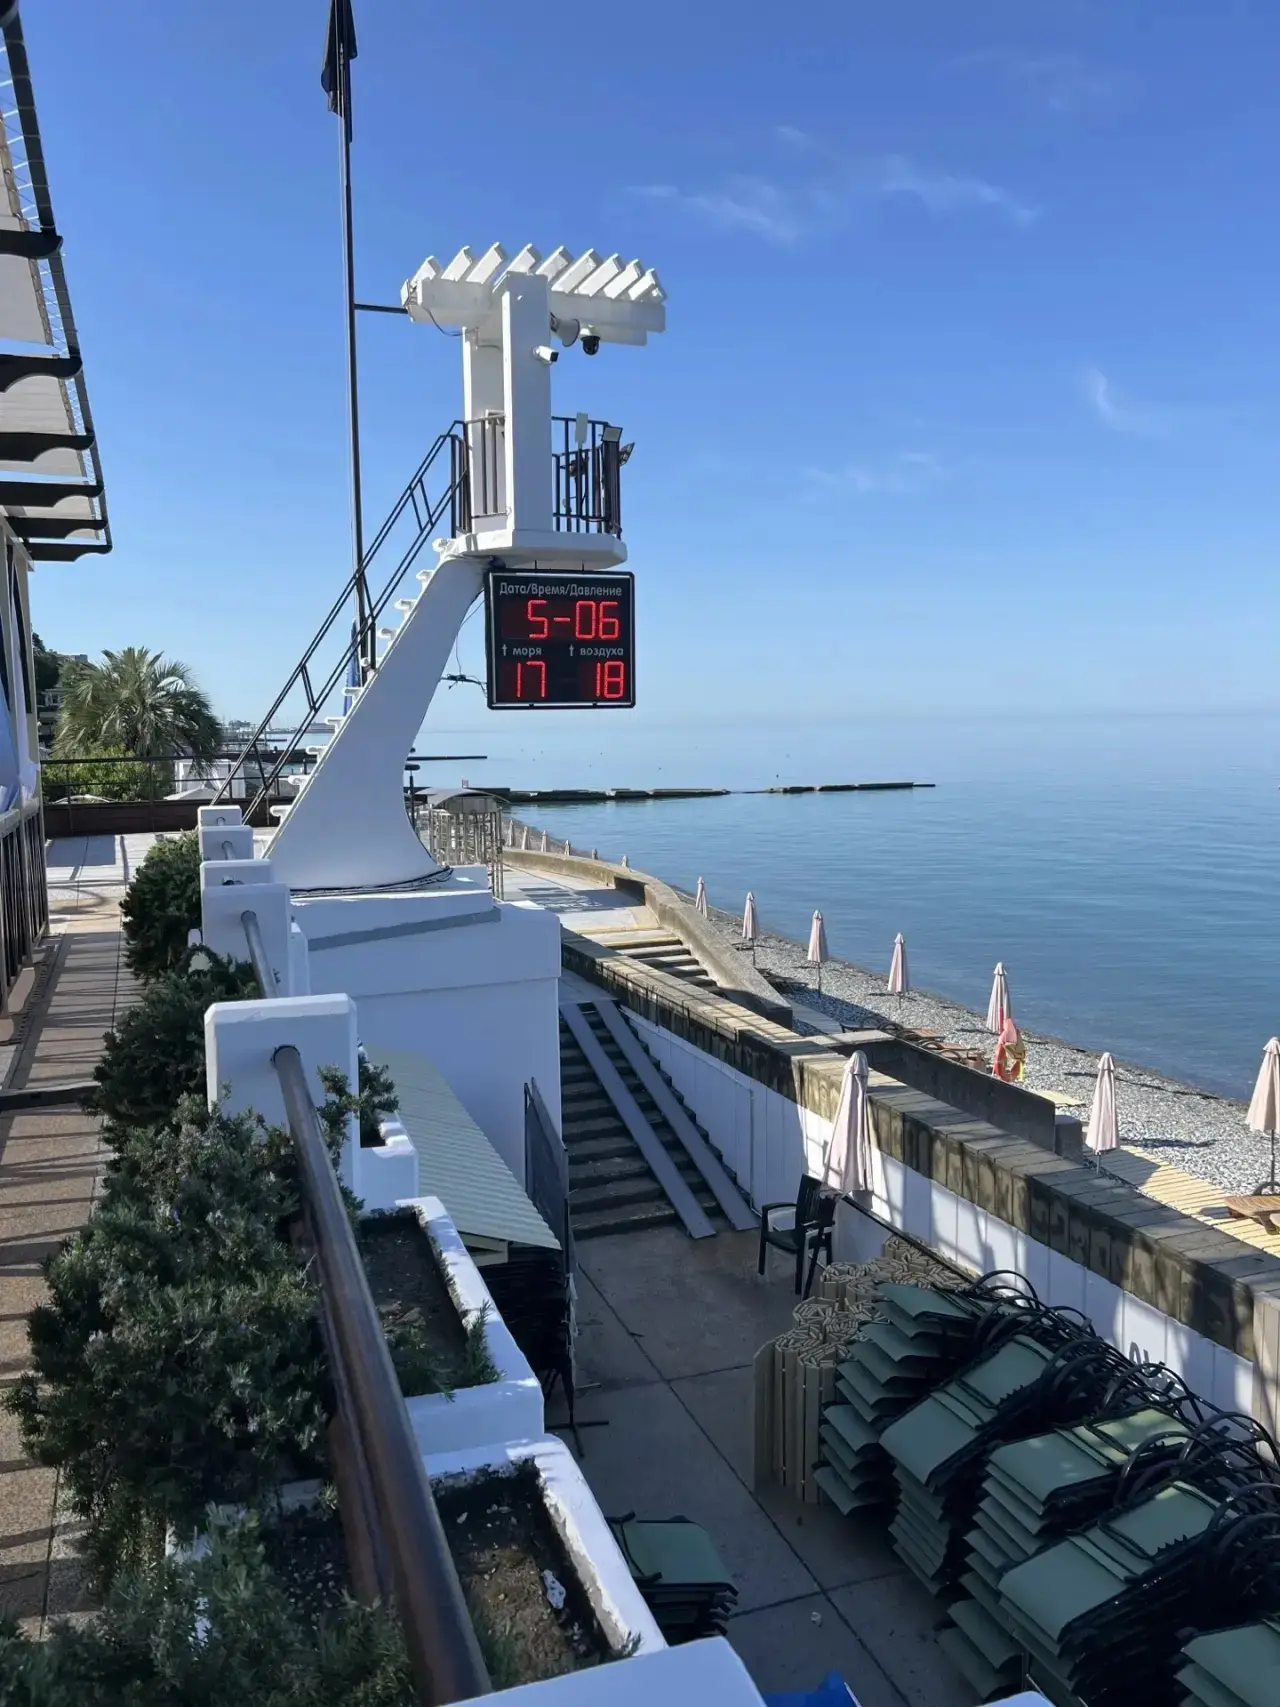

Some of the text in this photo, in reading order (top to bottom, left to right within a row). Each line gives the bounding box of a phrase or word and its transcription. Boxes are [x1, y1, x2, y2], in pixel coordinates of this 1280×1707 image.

[499, 582, 623, 597] Дата/Время/Давление
[512, 646, 624, 658] моря воздуха
[516, 661, 546, 698] 17
[595, 661, 625, 699] 18
